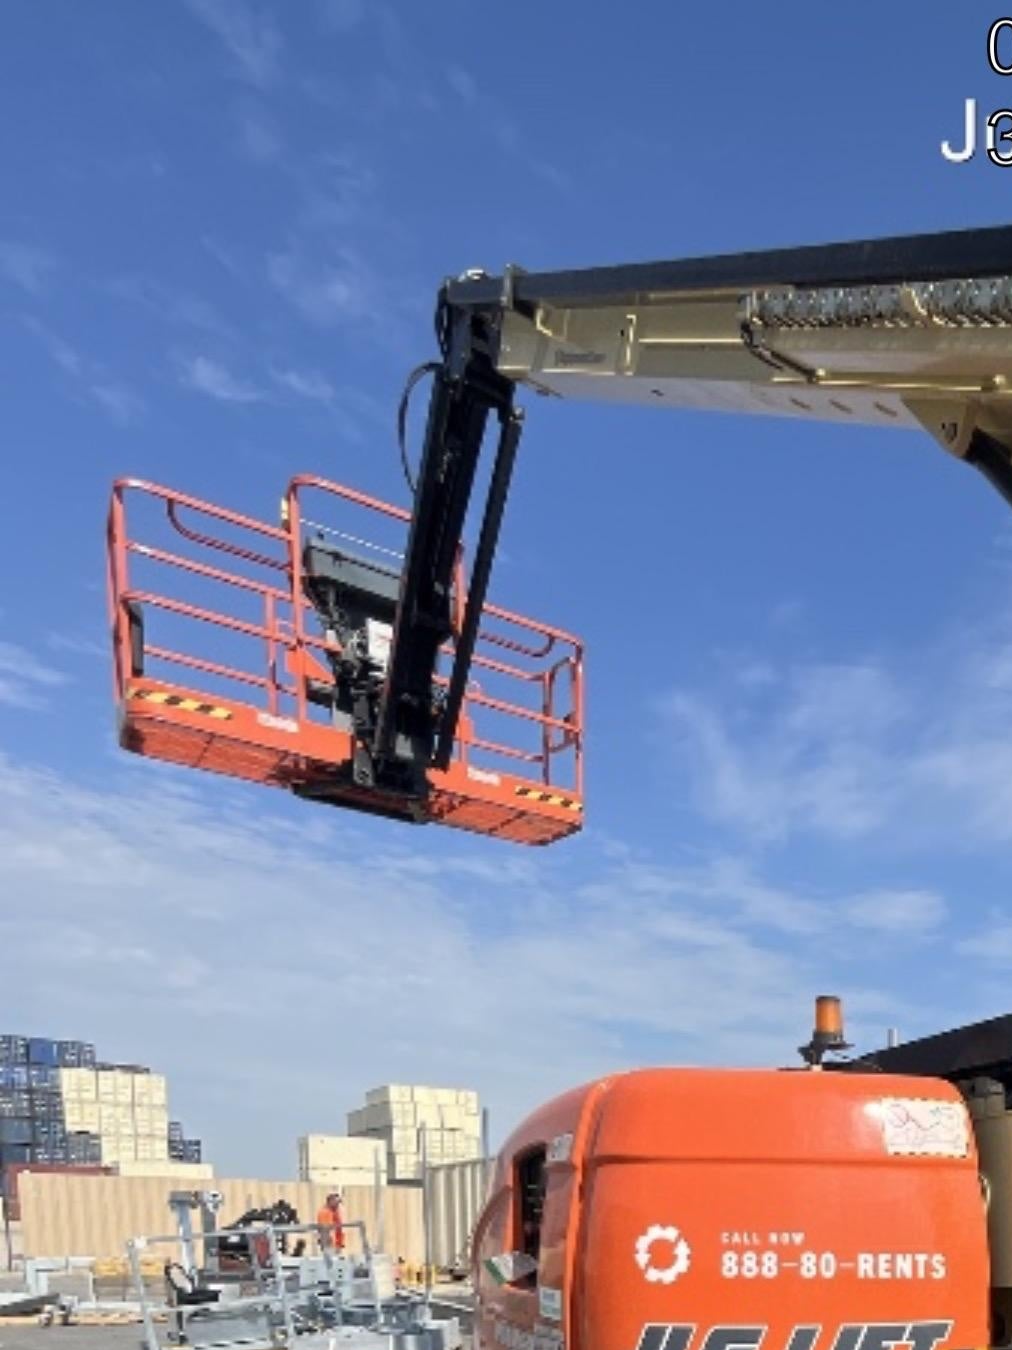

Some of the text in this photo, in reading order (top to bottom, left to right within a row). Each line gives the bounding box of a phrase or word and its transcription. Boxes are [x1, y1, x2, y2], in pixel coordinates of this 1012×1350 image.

[721, 1232, 805, 1245] CALL NOW
[721, 1251, 946, 1279] 888-80-RENTS
